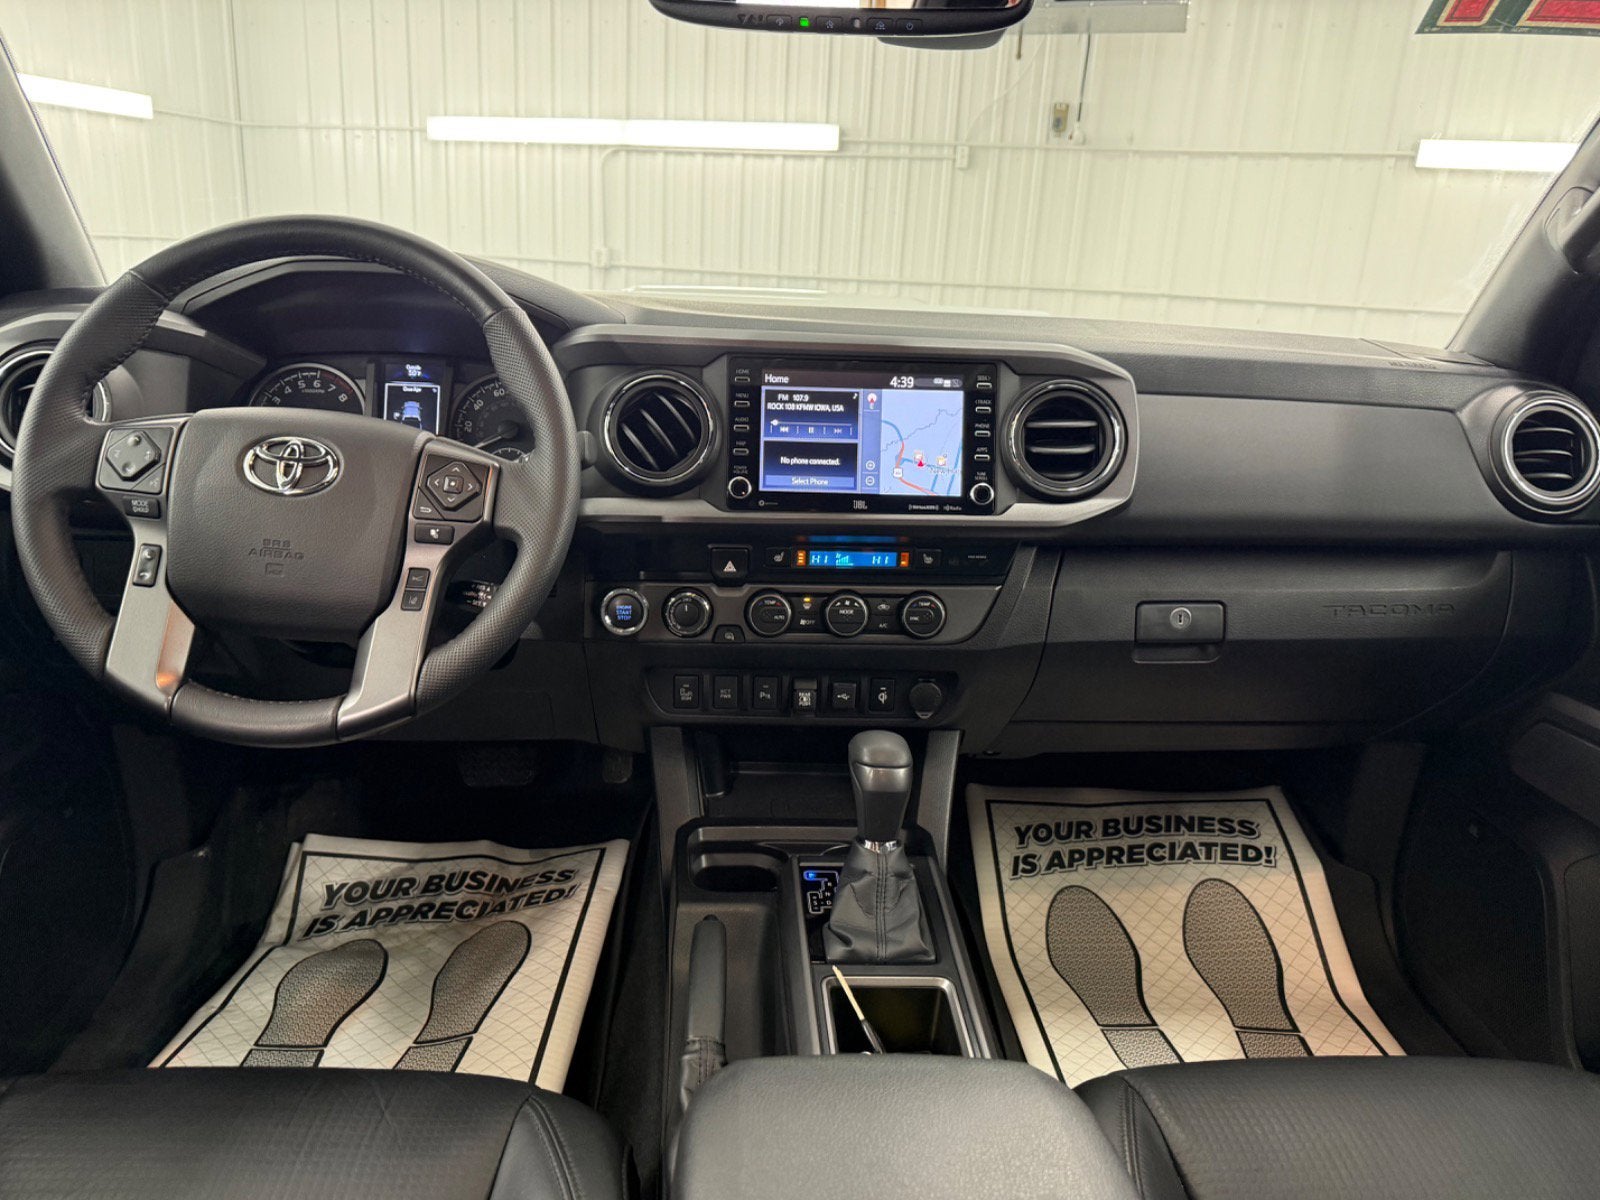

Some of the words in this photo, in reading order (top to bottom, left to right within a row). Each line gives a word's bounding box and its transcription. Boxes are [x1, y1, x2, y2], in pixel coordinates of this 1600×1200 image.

[765, 374, 789, 383] Home
[889, 376, 914, 388] 4:39
[298, 380, 306, 389] 5
[313, 380, 321, 388] 6
[328, 384, 336, 392] 7
[284, 386, 292, 394] 4
[493, 388, 505, 397] 60
[272, 396, 281, 405] 3
[338, 393, 348, 402] 8
[474, 400, 484, 411] 40
[767, 402, 784, 410] ROCK
[464, 420, 472, 432] 20
[780, 456, 790, 464] No
[791, 457, 808, 466] phone
[809, 458, 840, 466] connected.
[791, 477, 808, 485] Select
[853, 500, 867, 509] JBL
[262, 539, 291, 547] SRS
[249, 549, 304, 560] AIRBAG
[1322, 604, 1456, 618] TACOMA
[1014, 819, 1096, 847] YOUR
[1101, 814, 1259, 838] BUSINESS
[1011, 852, 1039, 878] IS
[1044, 842, 1277, 872] APPRECIATED!
[322, 877, 418, 910] YOUR
[421, 868, 578, 897] BUSINESS
[302, 914, 340, 940] IS
[342, 884, 581, 933] APPRECIATED!
